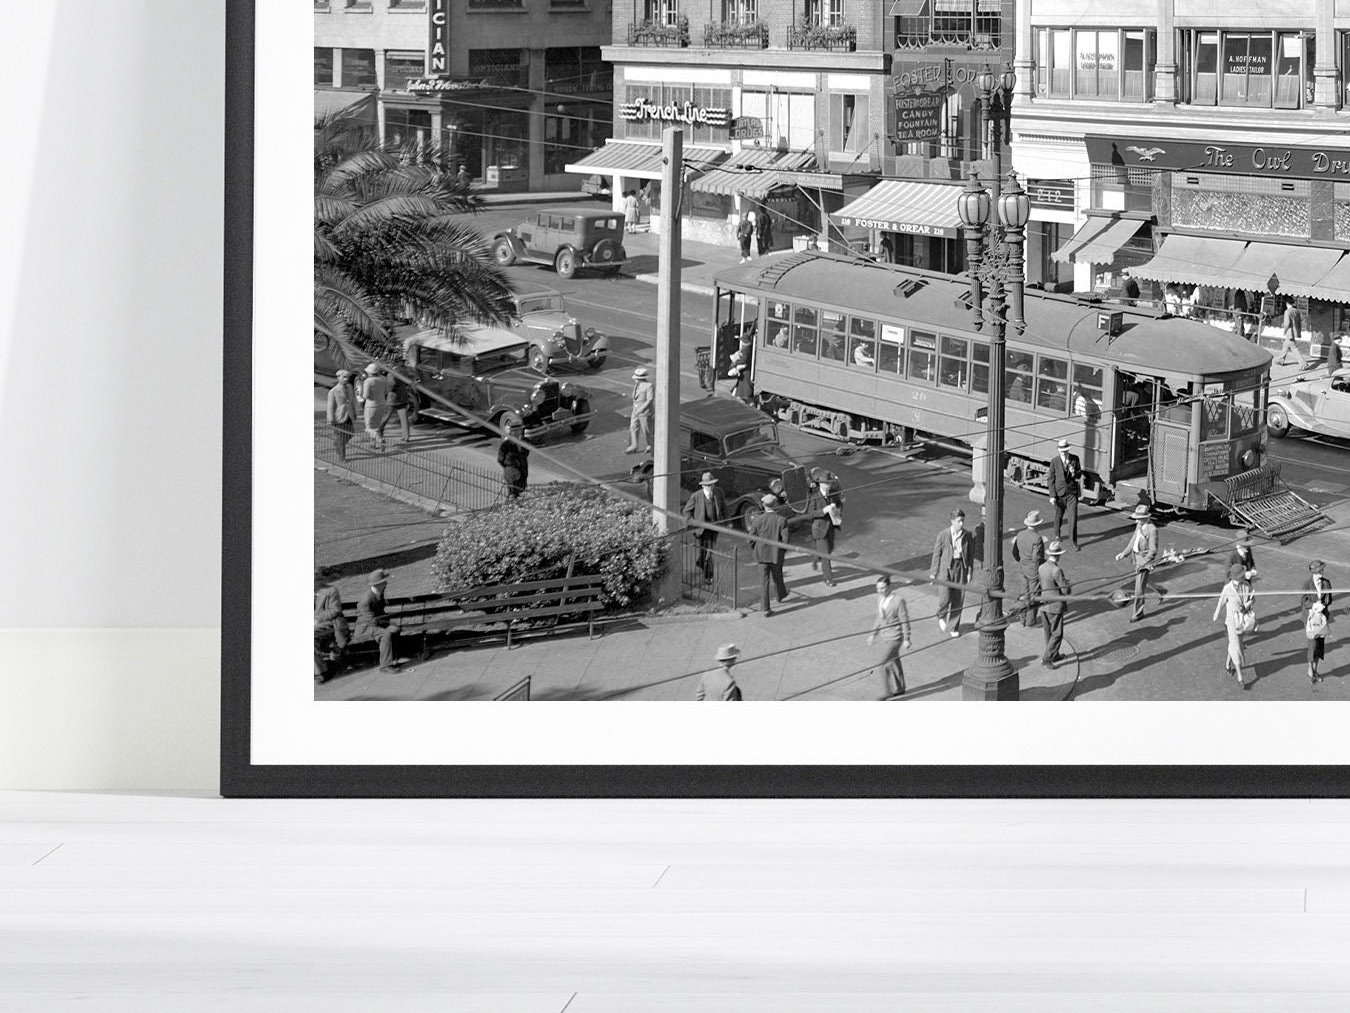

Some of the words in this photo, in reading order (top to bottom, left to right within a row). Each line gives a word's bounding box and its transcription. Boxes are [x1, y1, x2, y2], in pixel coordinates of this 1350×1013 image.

[1249, 66, 1264, 74] TAILOR
[893, 66, 941, 94] FOSTER
[635, 98, 680, 120] French
[681, 101, 706, 124] Line
[902, 109, 933, 119] CANDY
[898, 119, 938, 129] FOUNTAIN
[898, 129, 913, 139] TEA
[915, 128, 938, 137] ROOM
[1205, 145, 1233, 168] The
[1252, 148, 1291, 171] Owl
[1037, 189, 1062, 202] 212
[855, 218, 889, 230] FOSTER
[892, 223, 898, 231] &
[900, 223, 930, 234] OREAR
[1098, 314, 1110, 328] F
